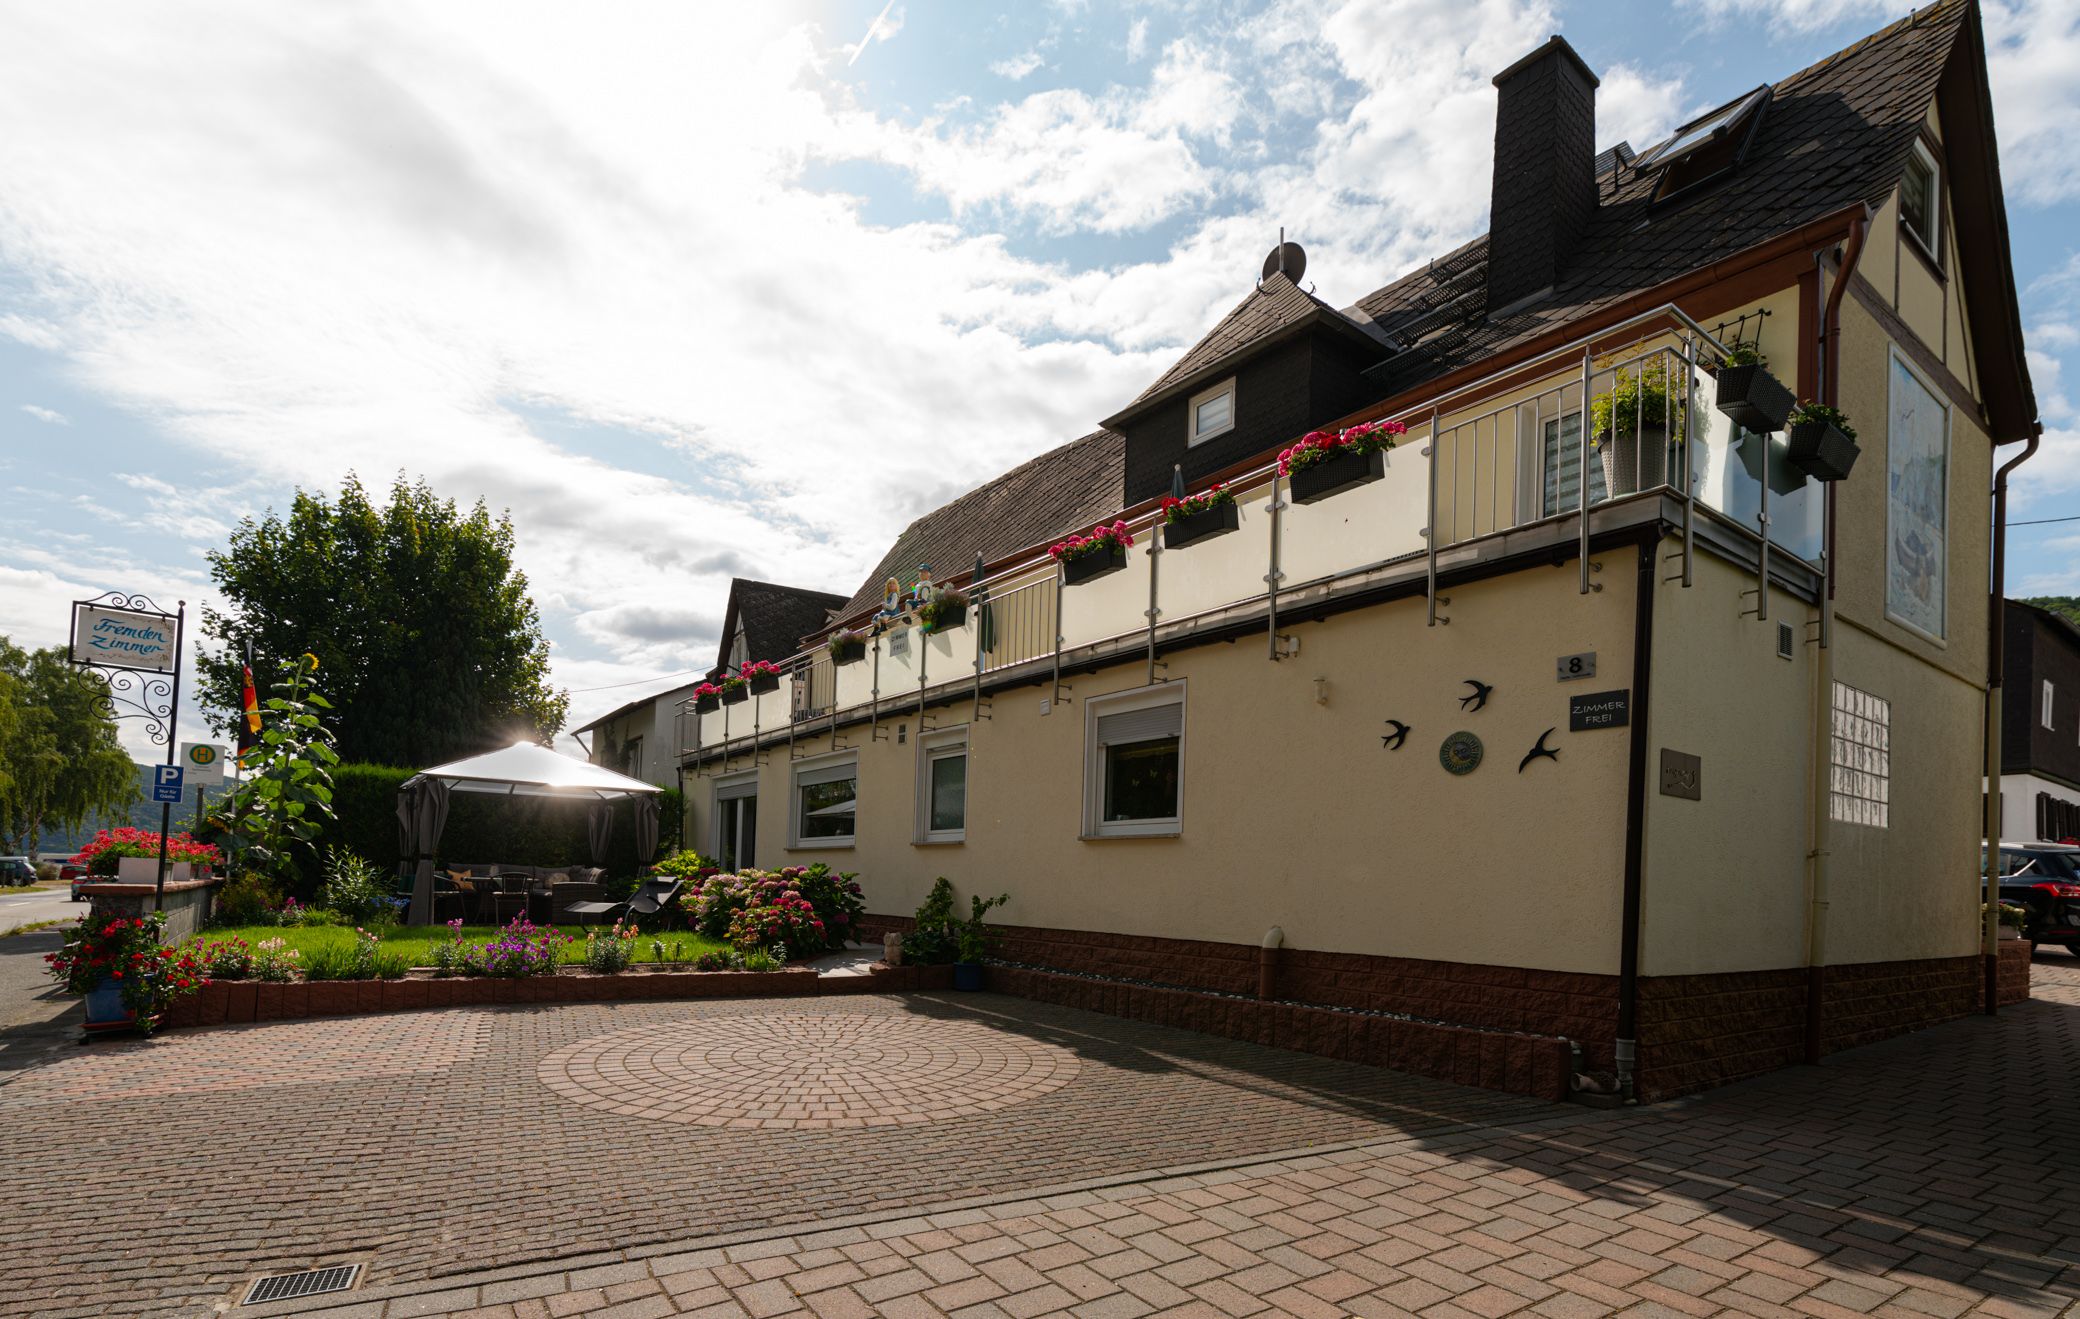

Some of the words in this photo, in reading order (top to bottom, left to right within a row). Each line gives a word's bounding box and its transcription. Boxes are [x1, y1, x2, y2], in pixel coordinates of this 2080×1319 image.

[93, 618, 168, 642] Fremden
[88, 634, 164, 655] Zimmer
[1569, 657, 1582, 673] 8
[1572, 701, 1626, 714] ZIMMER
[1585, 714, 1612, 724] FREI
[197, 748, 209, 760] H
[160, 767, 179, 784] P
